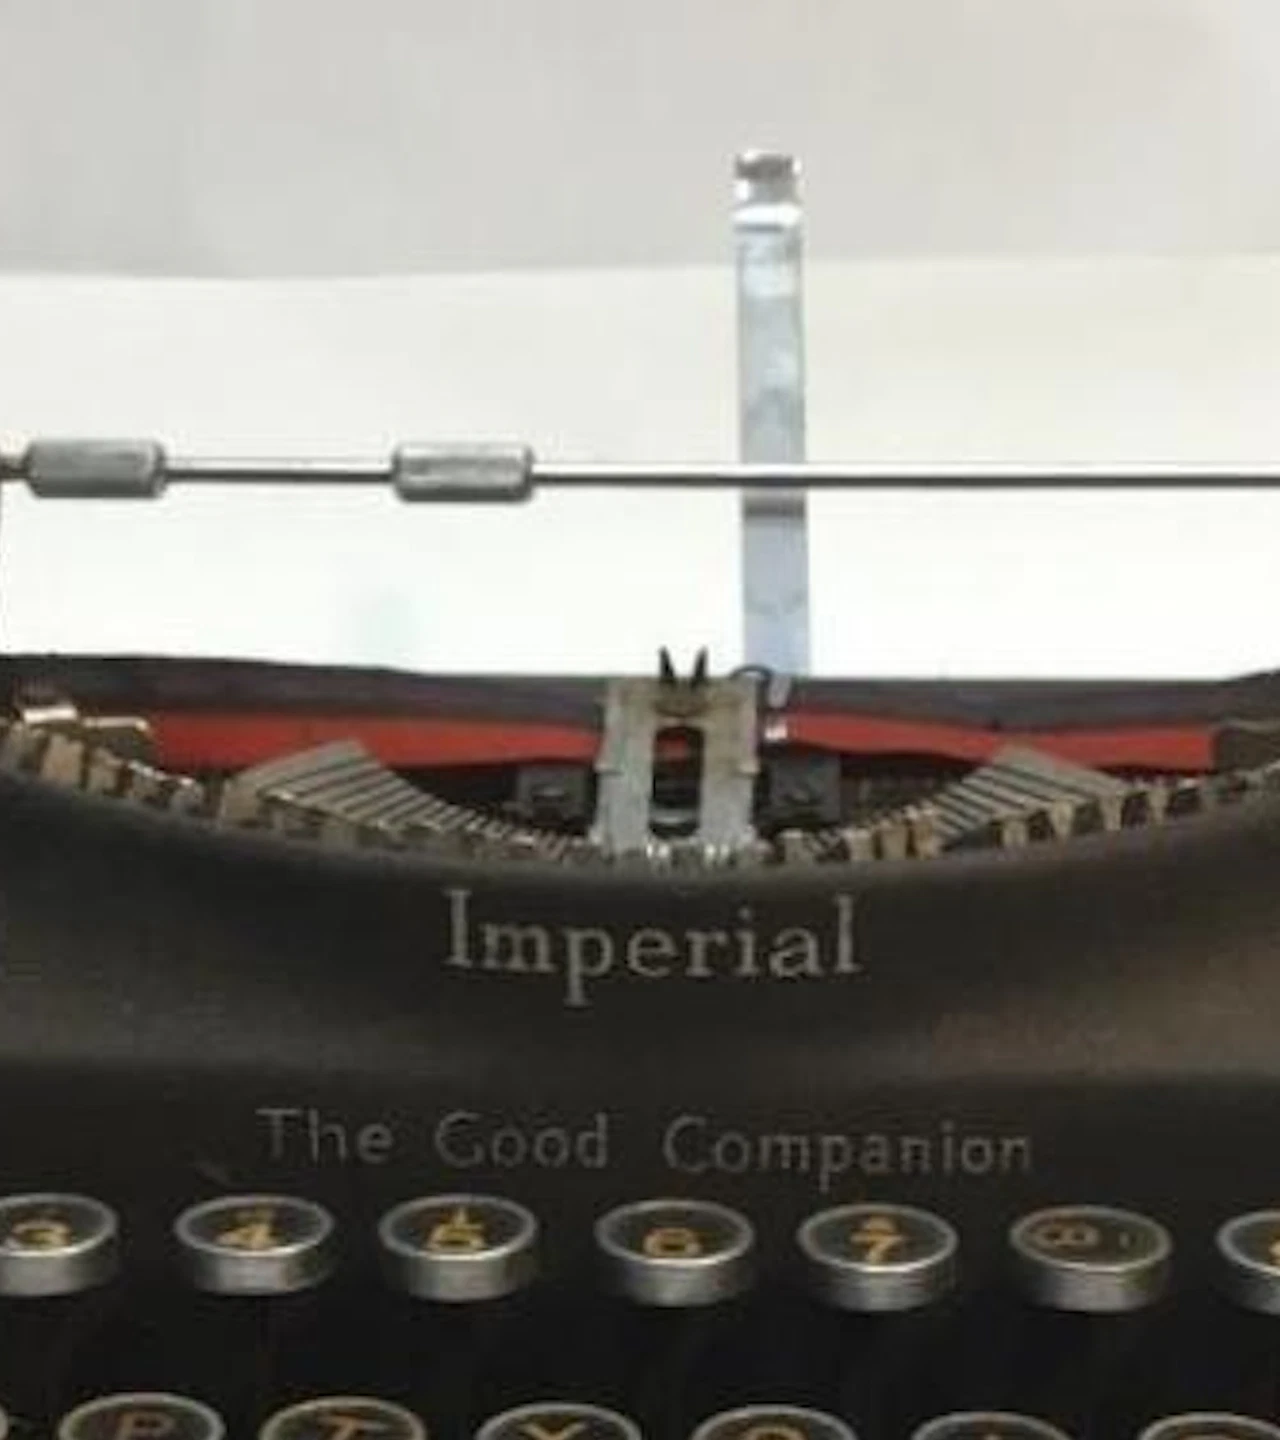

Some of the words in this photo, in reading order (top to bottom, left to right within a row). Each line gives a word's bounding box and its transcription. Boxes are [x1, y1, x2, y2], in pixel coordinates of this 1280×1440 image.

[443, 887, 866, 1008] Imperial
[255, 1107, 397, 1164] The
[433, 1111, 611, 1170] Good
[660, 1115, 1034, 1195] Companion
